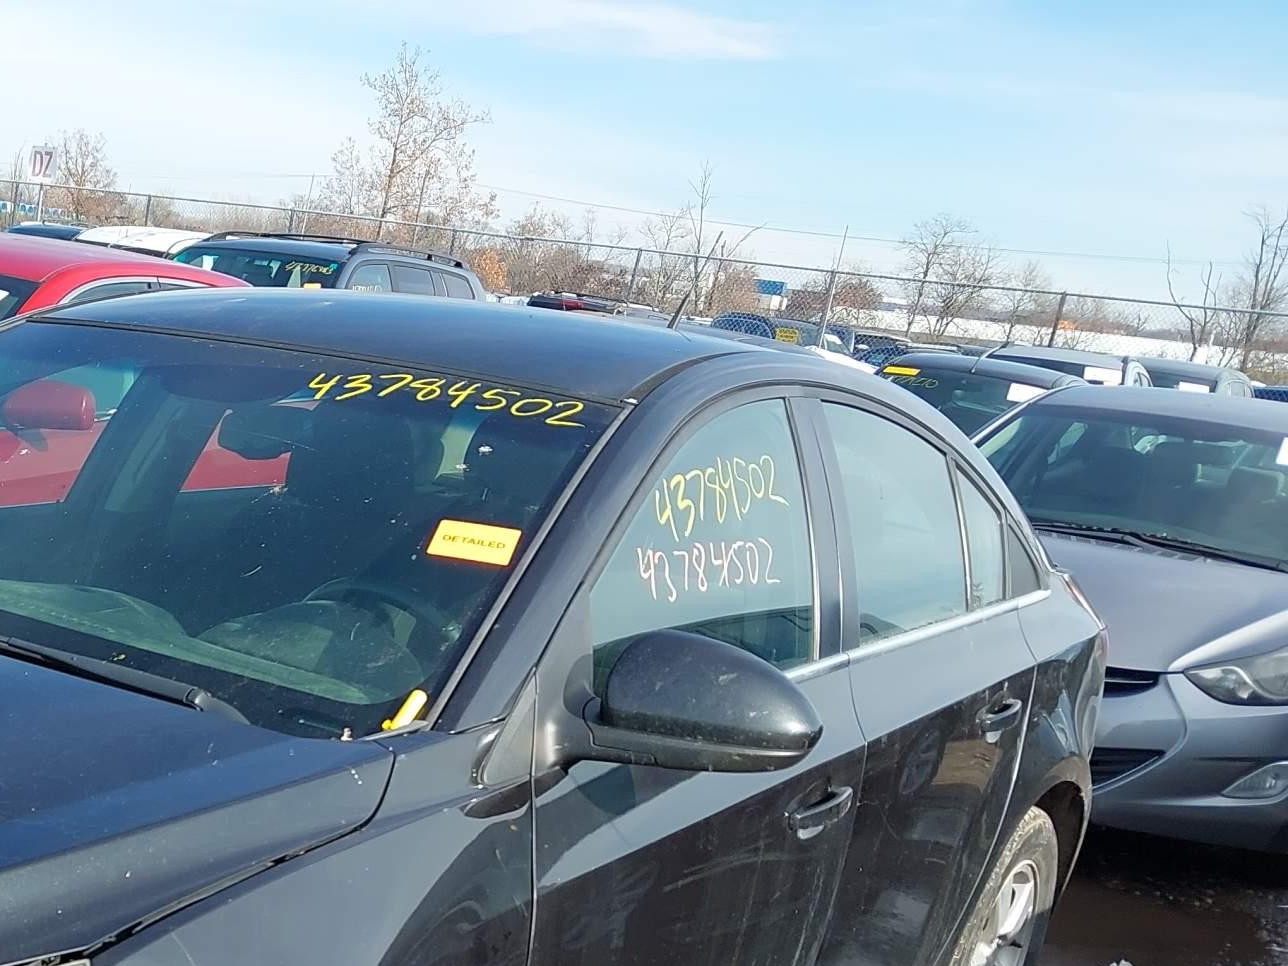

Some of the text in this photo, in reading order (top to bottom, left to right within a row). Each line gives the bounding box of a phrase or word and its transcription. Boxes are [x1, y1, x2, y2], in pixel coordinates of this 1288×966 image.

[307, 373, 585, 427] 43784502
[655, 455, 789, 542] 43784502
[442, 534, 506, 549] DETAILED
[637, 537, 781, 602] 43784502
